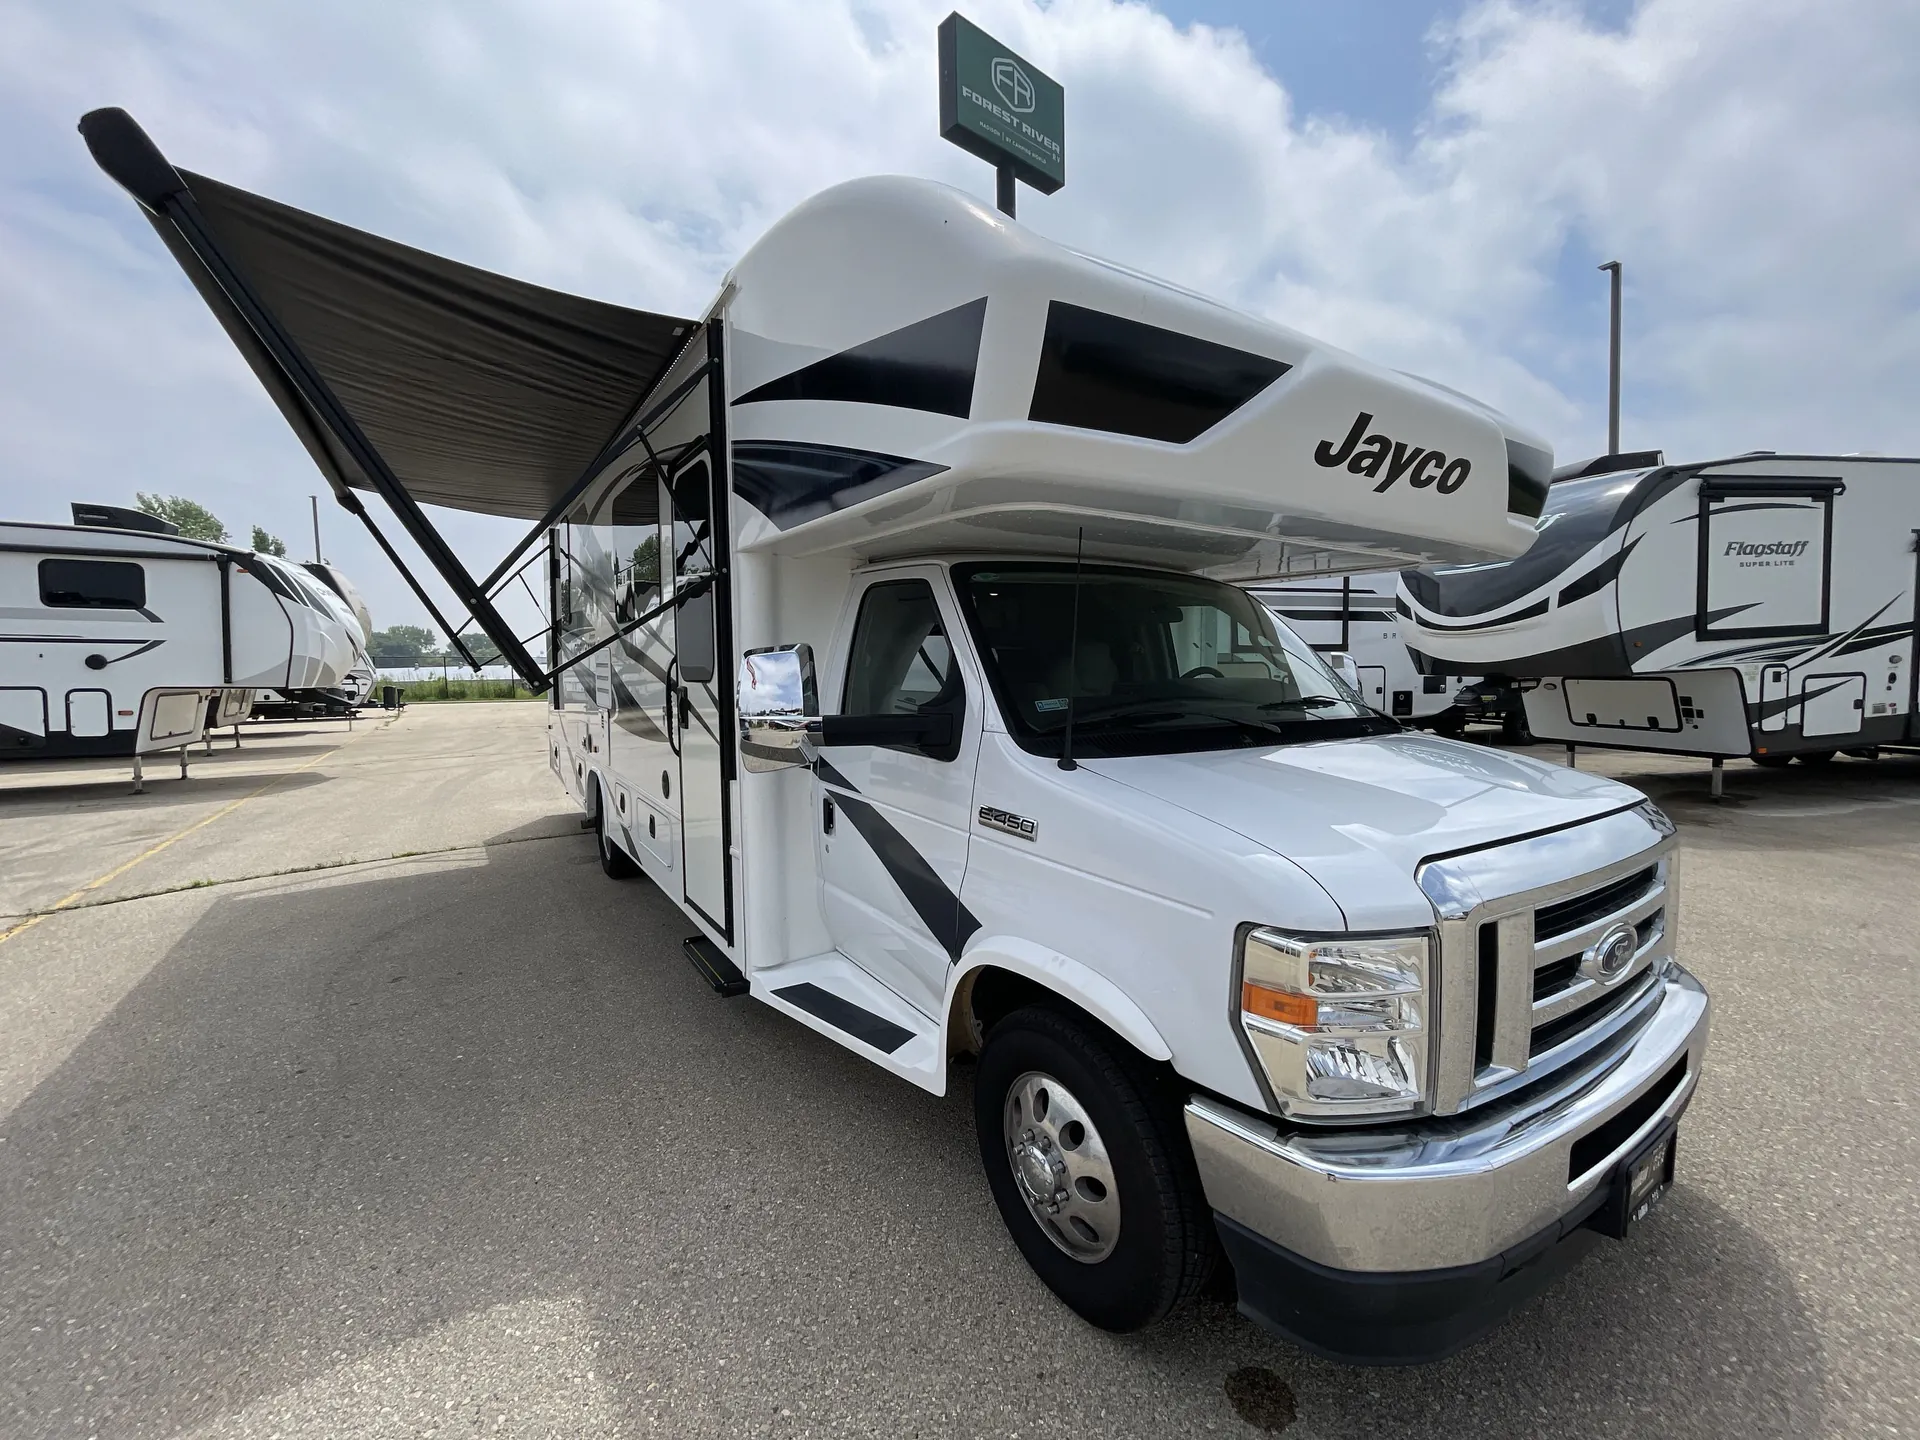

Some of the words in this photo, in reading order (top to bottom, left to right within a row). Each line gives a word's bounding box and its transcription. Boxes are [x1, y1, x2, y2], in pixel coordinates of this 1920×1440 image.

[961, 85, 1020, 128] FOREST
[1021, 122, 1061, 154] RIVER
[1314, 411, 1472, 495] Jayco
[1723, 540, 1810, 558] Flagstaff
